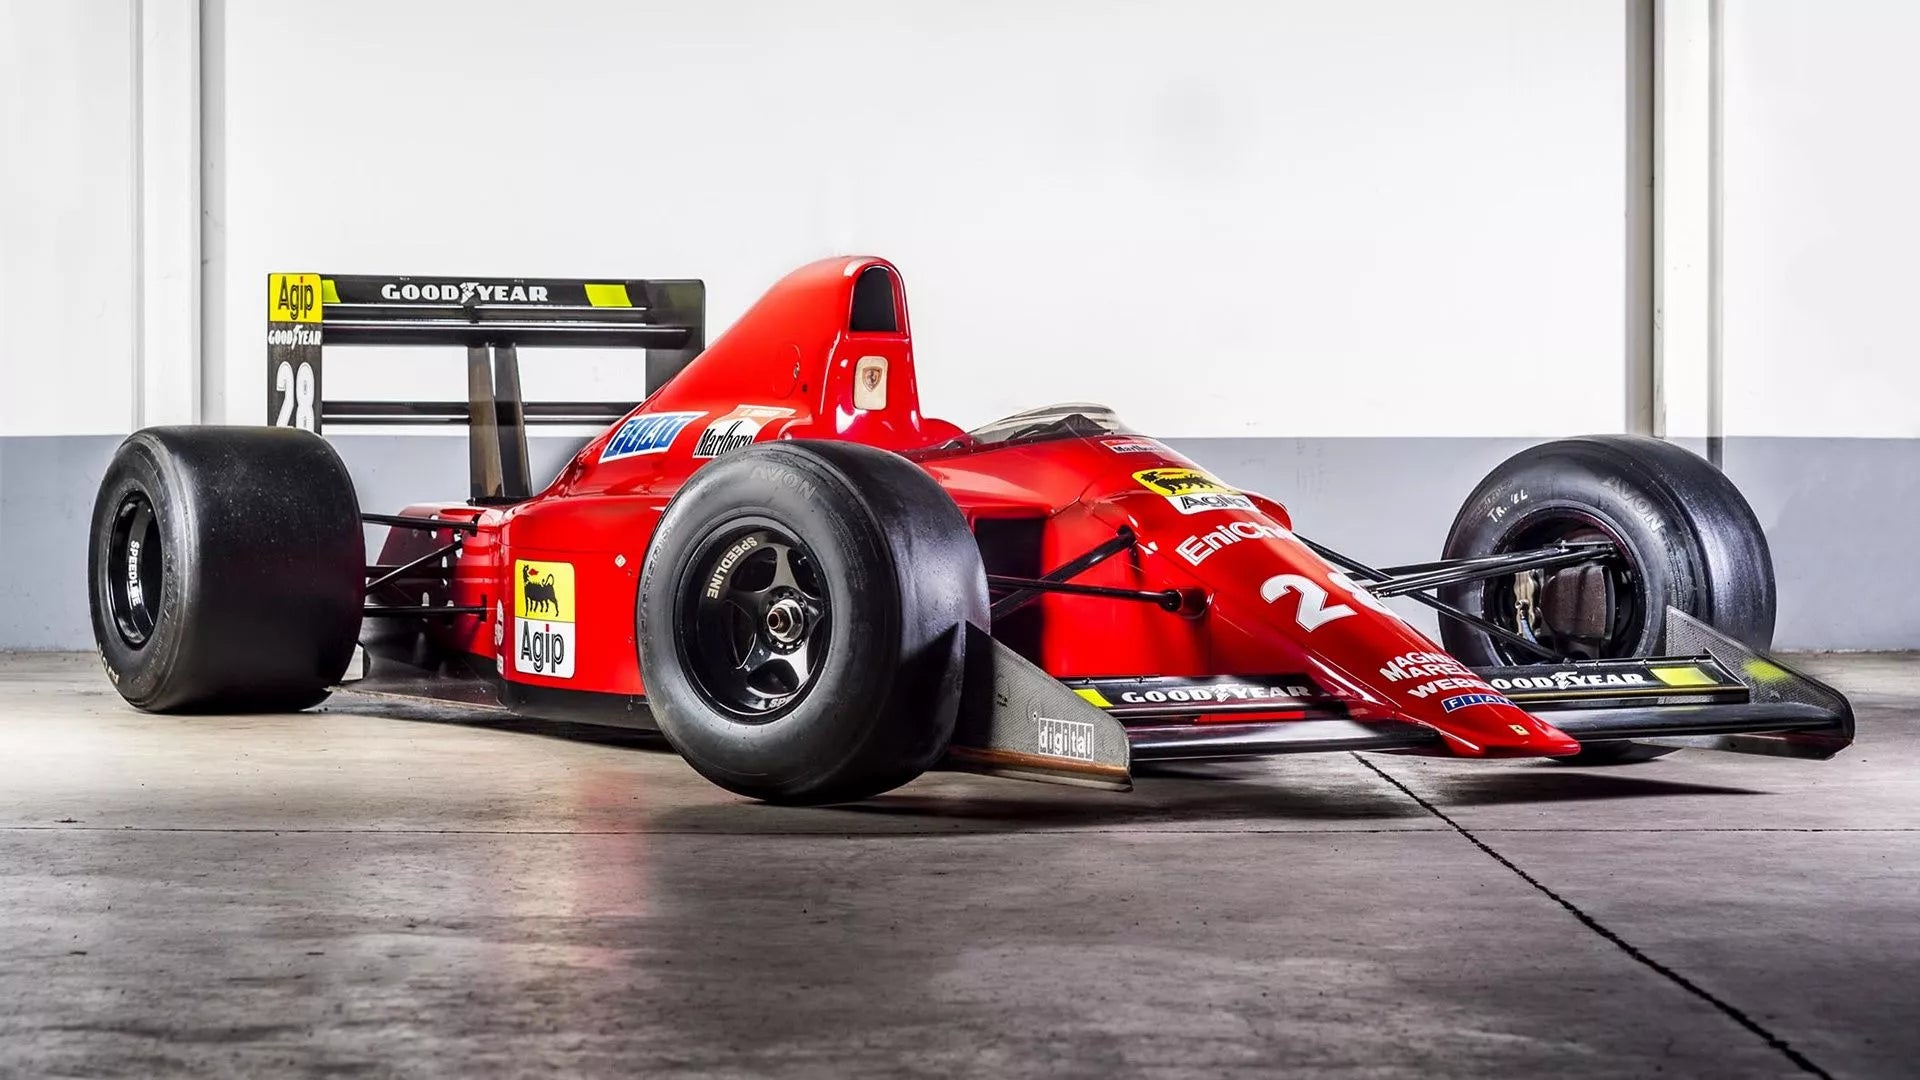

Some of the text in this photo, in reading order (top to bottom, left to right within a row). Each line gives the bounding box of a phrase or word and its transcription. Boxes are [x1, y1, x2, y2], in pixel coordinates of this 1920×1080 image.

[278, 275, 314, 320] Agip
[381, 283, 549, 303] GOODYEAR
[268, 326, 321, 347] GOODYEAR
[276, 361, 315, 433] 28
[606, 414, 697, 453] FIAT
[1180, 493, 1251, 510] Agip
[706, 536, 758, 600] SPEEDLINE
[521, 621, 564, 673] Agip
[1121, 684, 1312, 703] GOODYEAR
[1491, 672, 1647, 690] OODYEAR
[1039, 721, 1093, 758] digital
